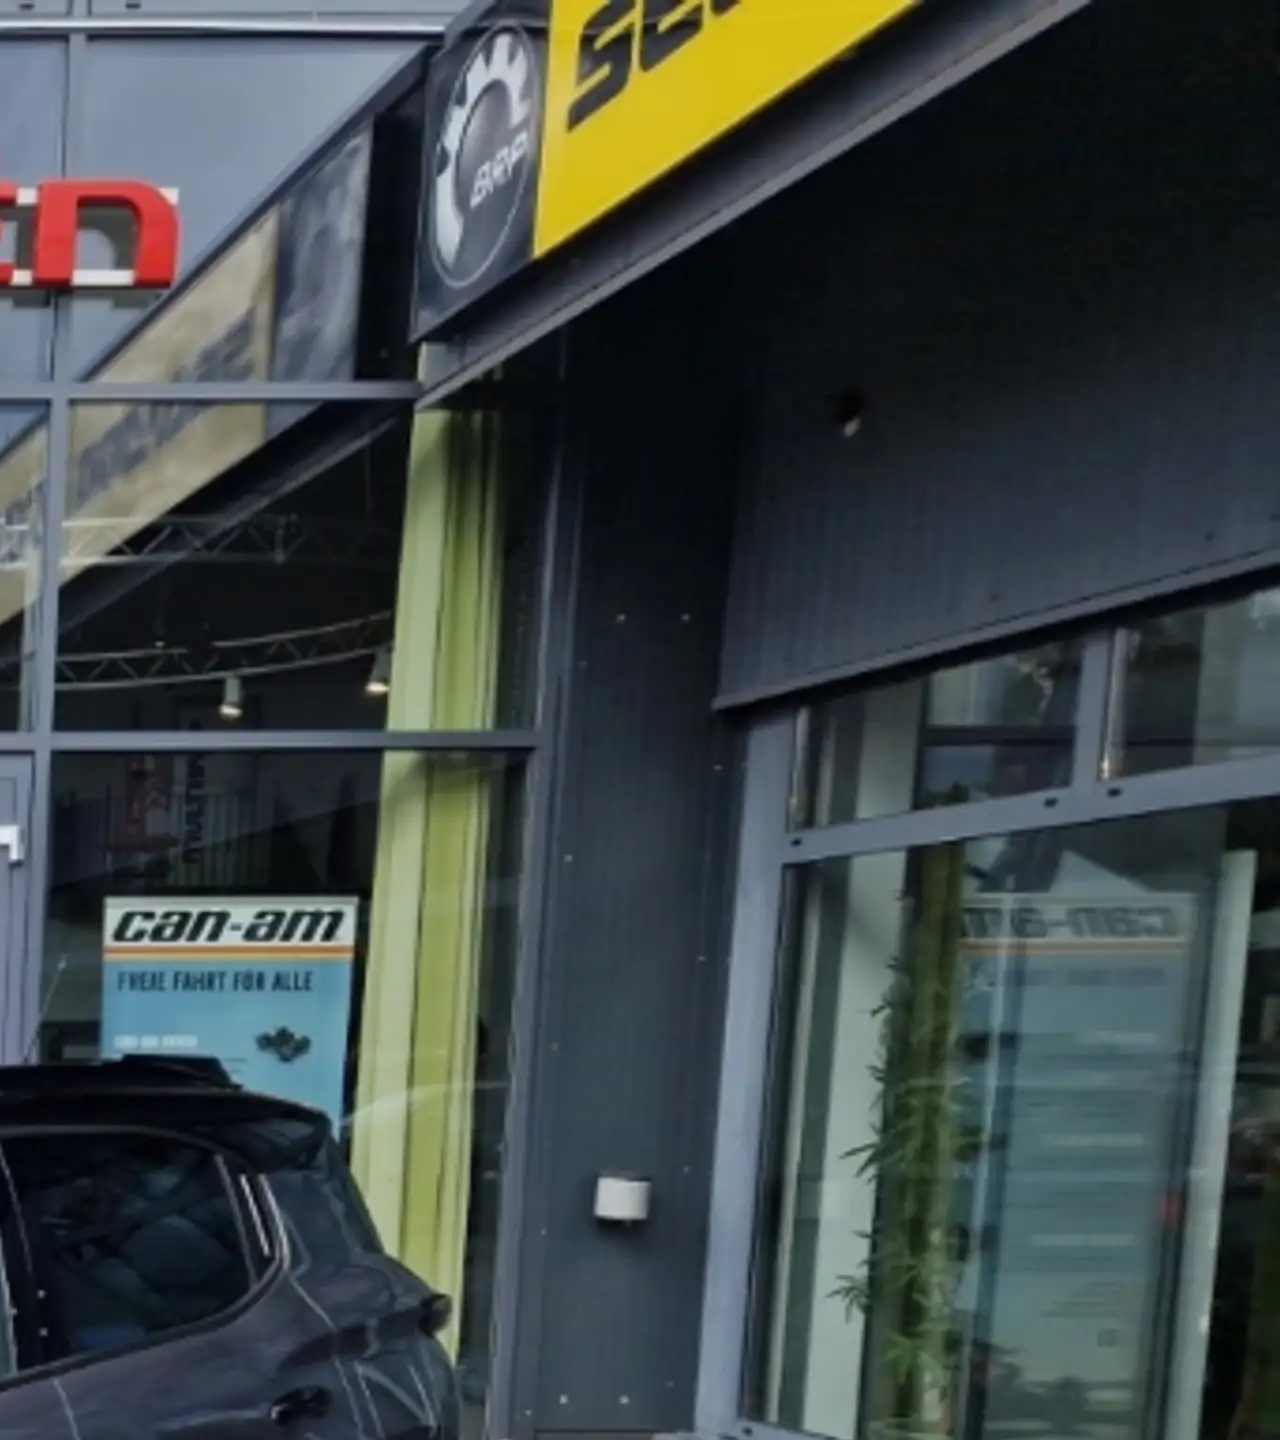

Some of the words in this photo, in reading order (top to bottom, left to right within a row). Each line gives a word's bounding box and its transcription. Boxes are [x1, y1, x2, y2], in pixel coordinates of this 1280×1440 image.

[566, 0, 742, 134] SE
[470, 129, 529, 210] BRP
[111, 910, 345, 942] can-am
[117, 970, 166, 993] FREIE
[173, 970, 228, 993] FAHRT
[271, 970, 314, 992] ALLE
